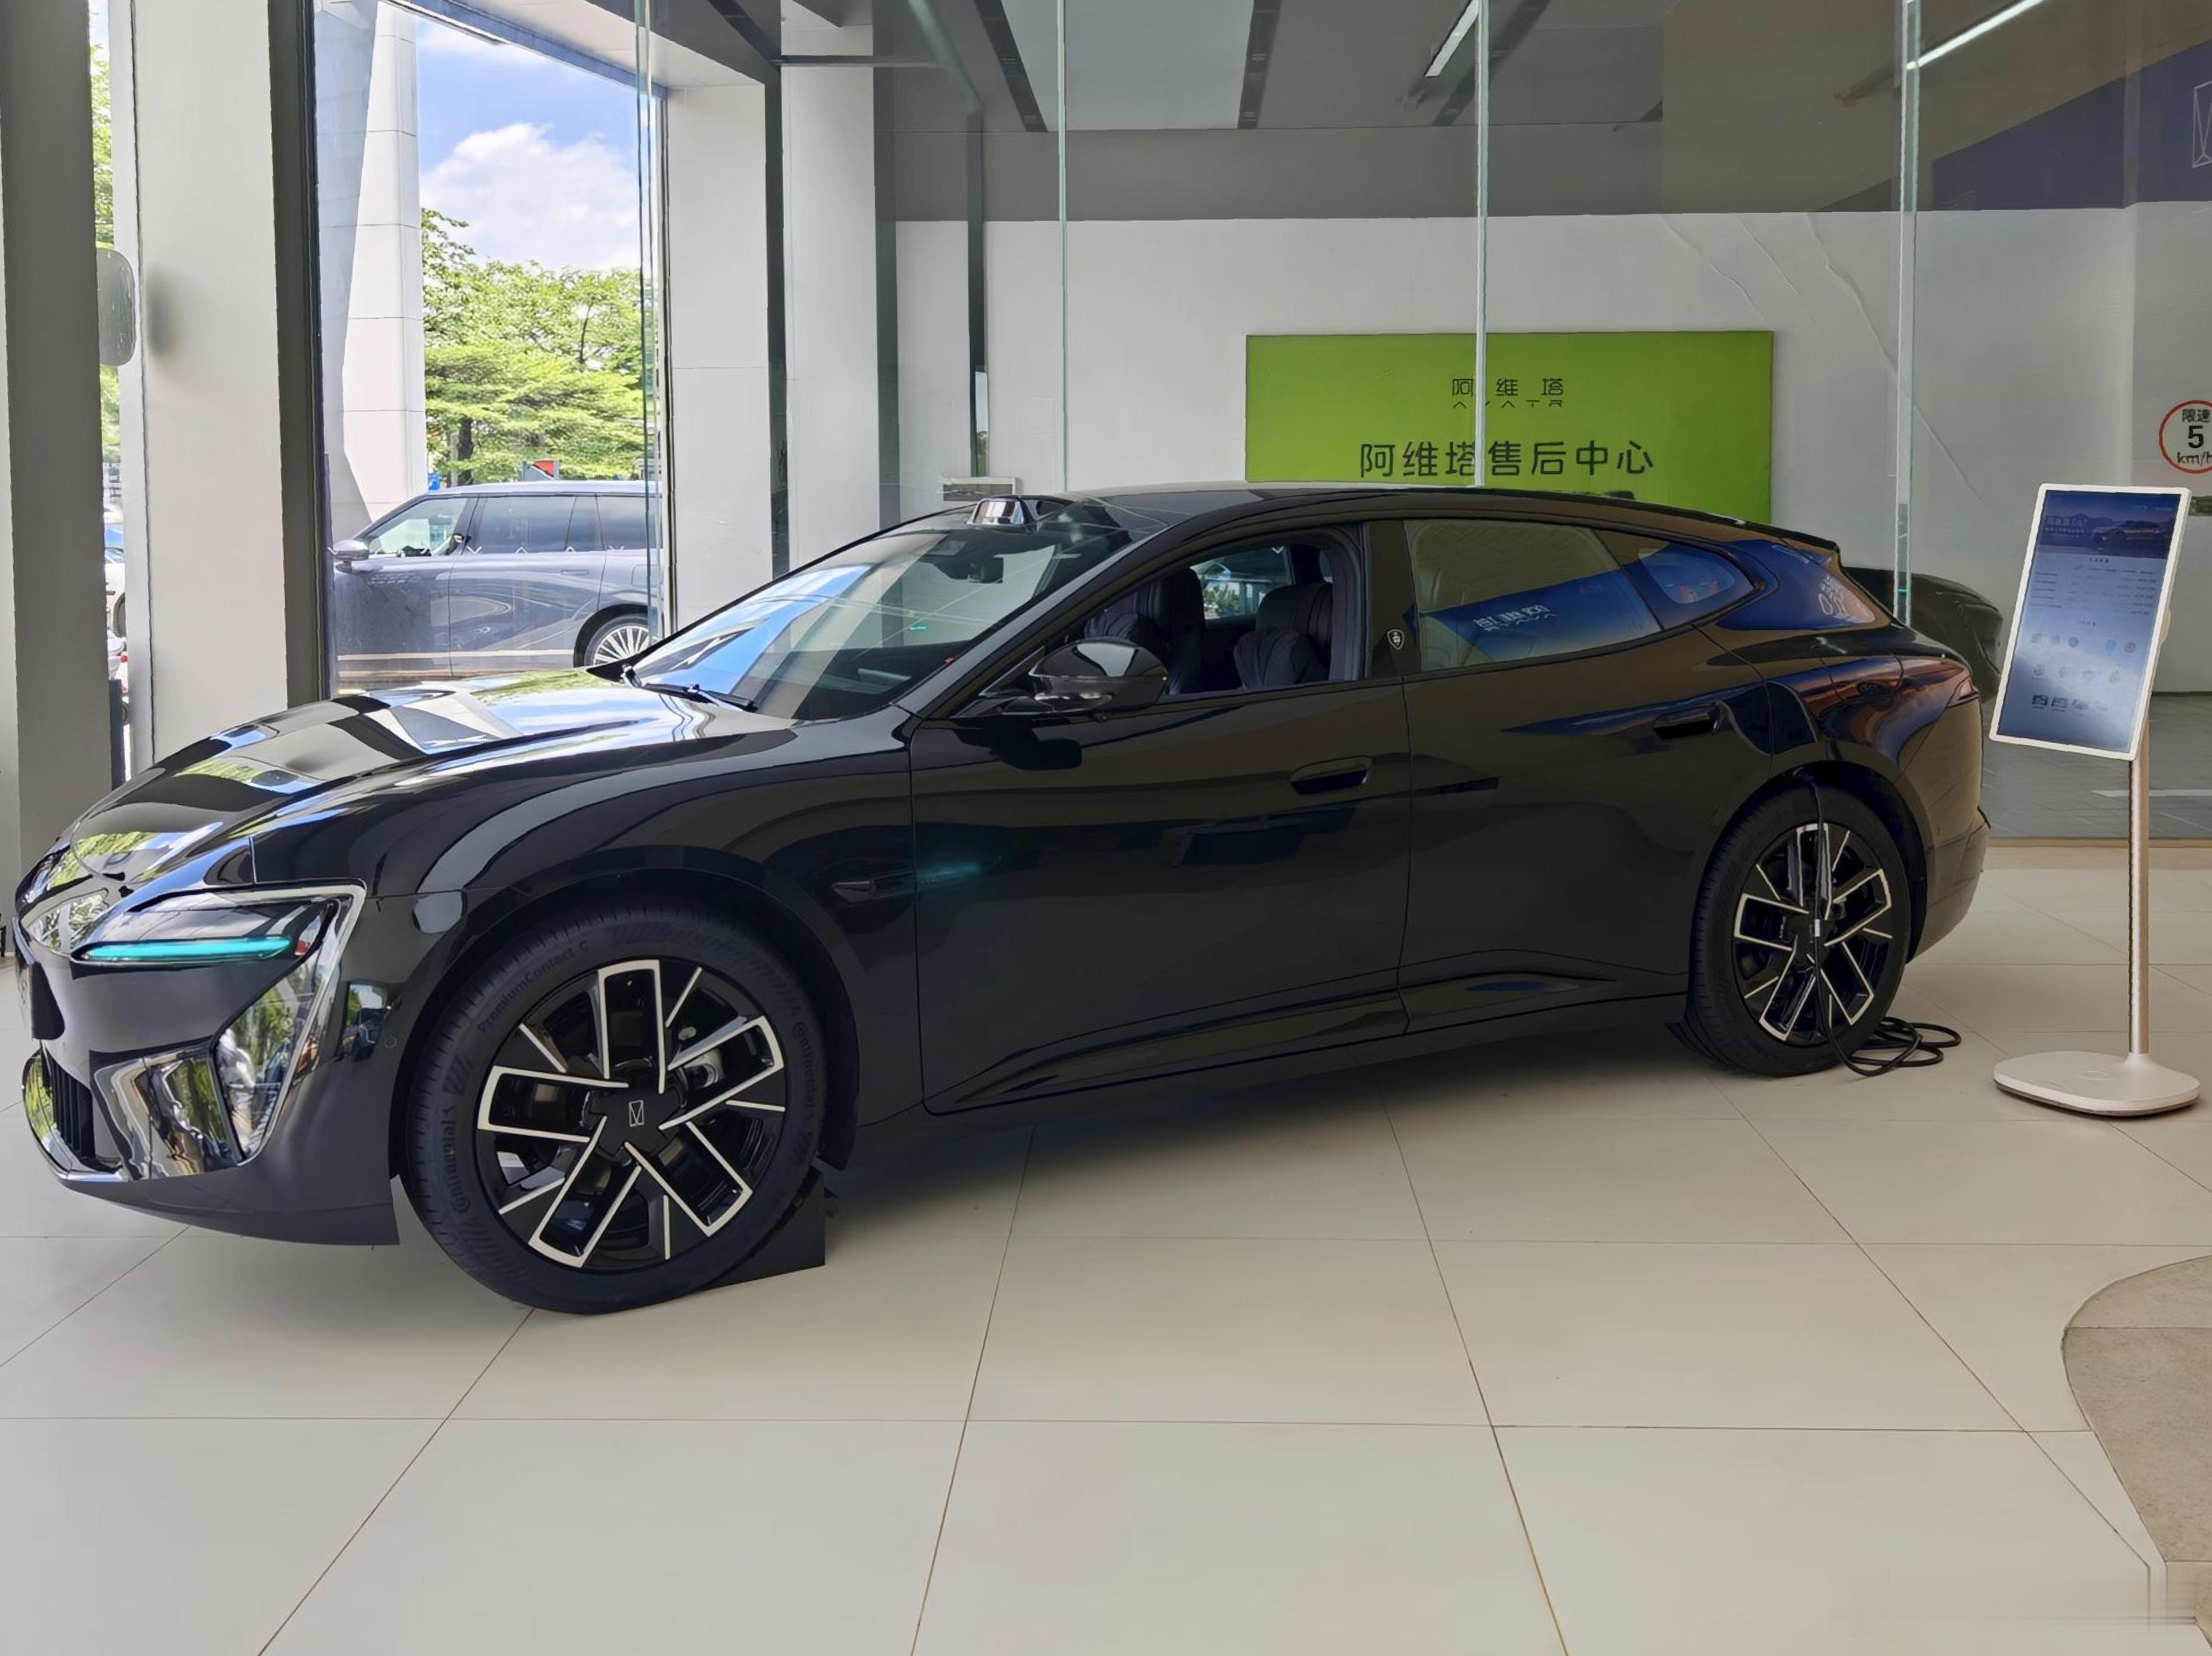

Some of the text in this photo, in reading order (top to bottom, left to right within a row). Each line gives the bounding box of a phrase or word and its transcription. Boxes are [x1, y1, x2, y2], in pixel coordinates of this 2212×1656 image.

[1452, 378, 1564, 397] 阿维塔
[1452, 399, 1564, 409] AATR
[2182, 409, 2211, 423] 限速
[2188, 425, 2204, 449] 5
[1359, 440, 1654, 478] 阿维塔售后中心
